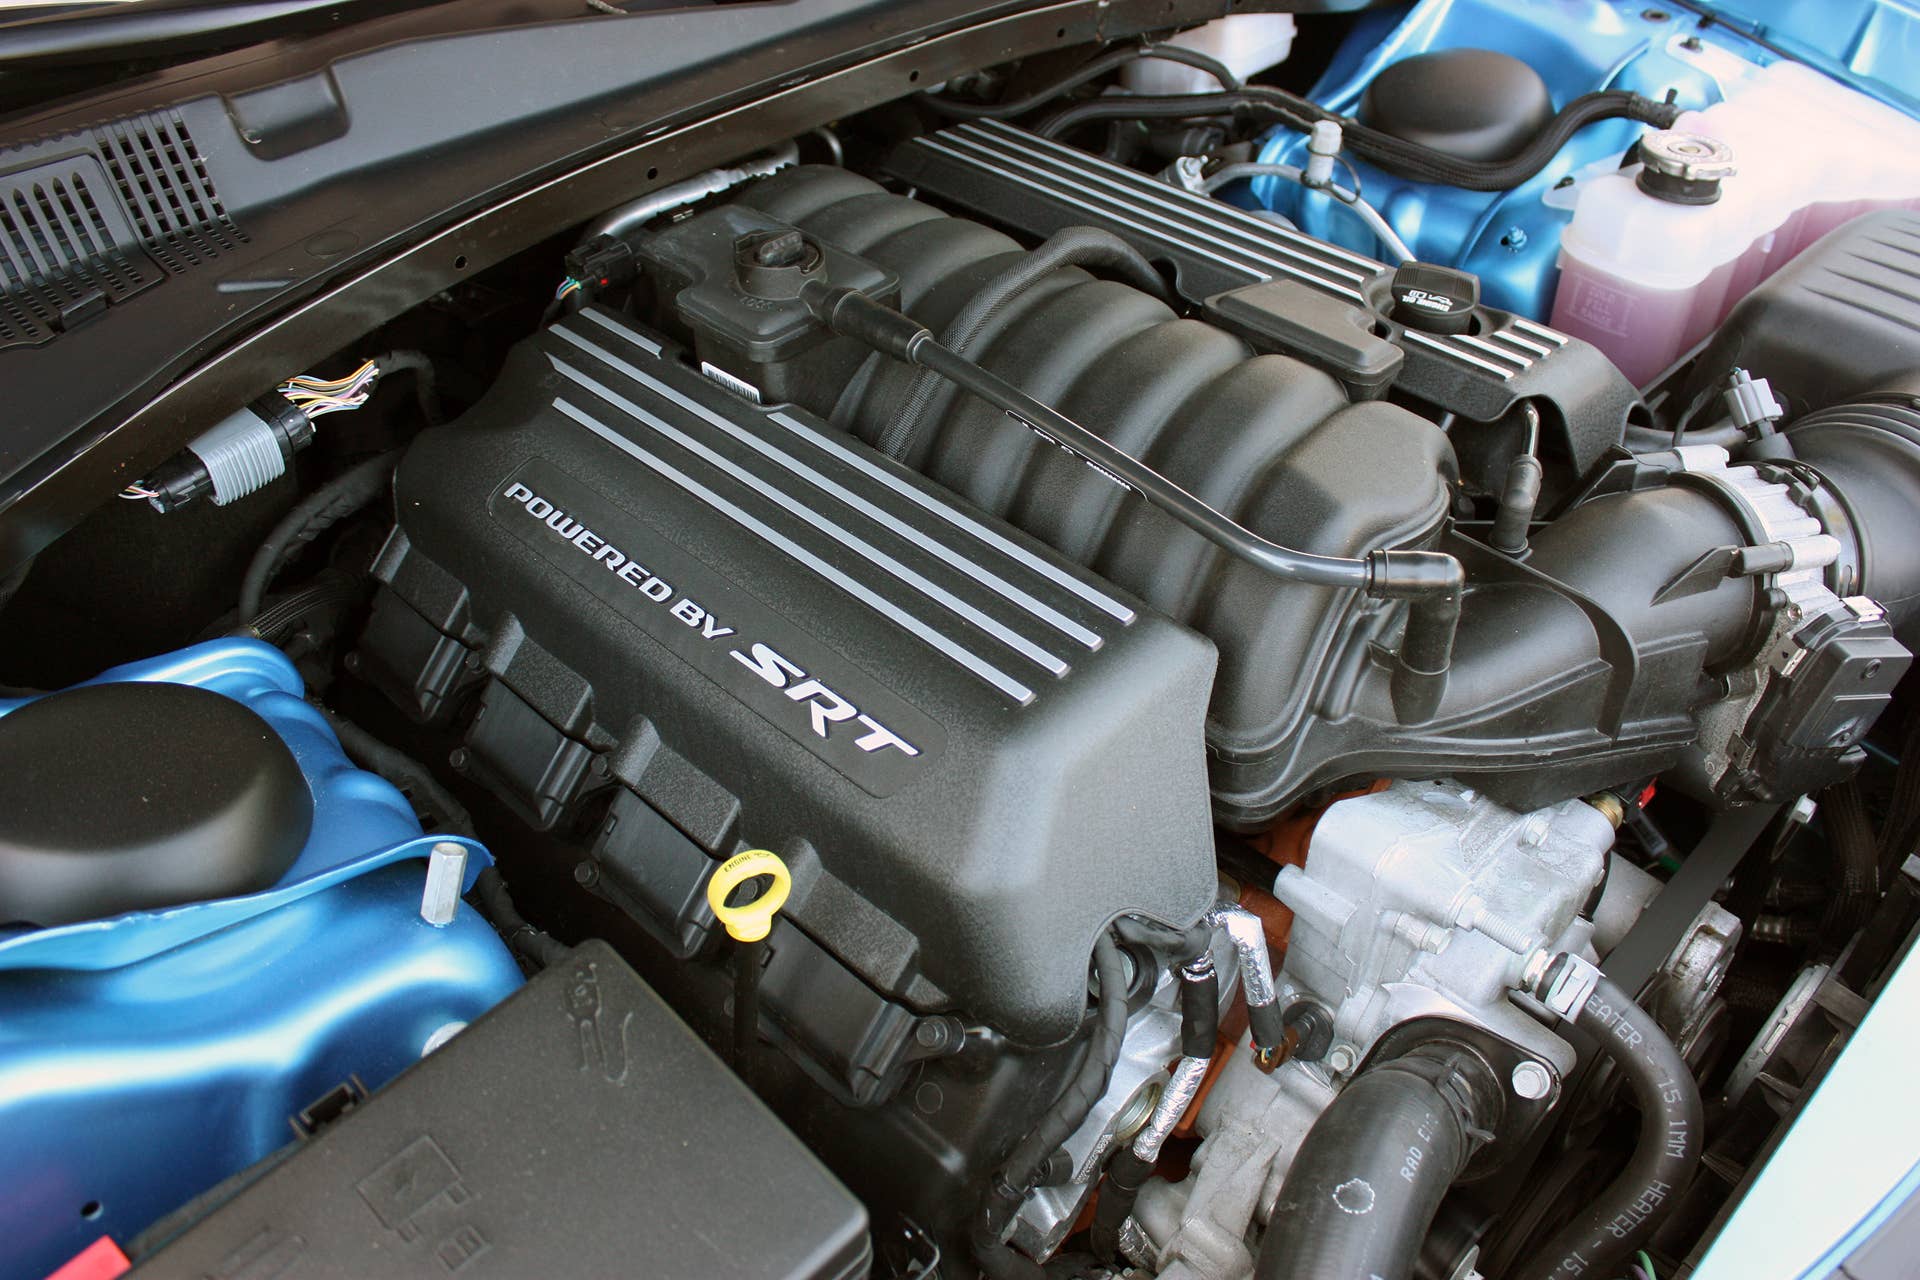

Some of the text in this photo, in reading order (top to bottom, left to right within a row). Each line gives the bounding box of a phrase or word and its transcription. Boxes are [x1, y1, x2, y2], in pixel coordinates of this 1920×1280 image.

[503, 482, 922, 757] POWERED BY SRT
[723, 855, 751, 872] ENGINE
[1585, 994, 1643, 1049] EATER
[1400, 1146, 1423, 1183] RAD
[1604, 1179, 1672, 1239] HEATER
